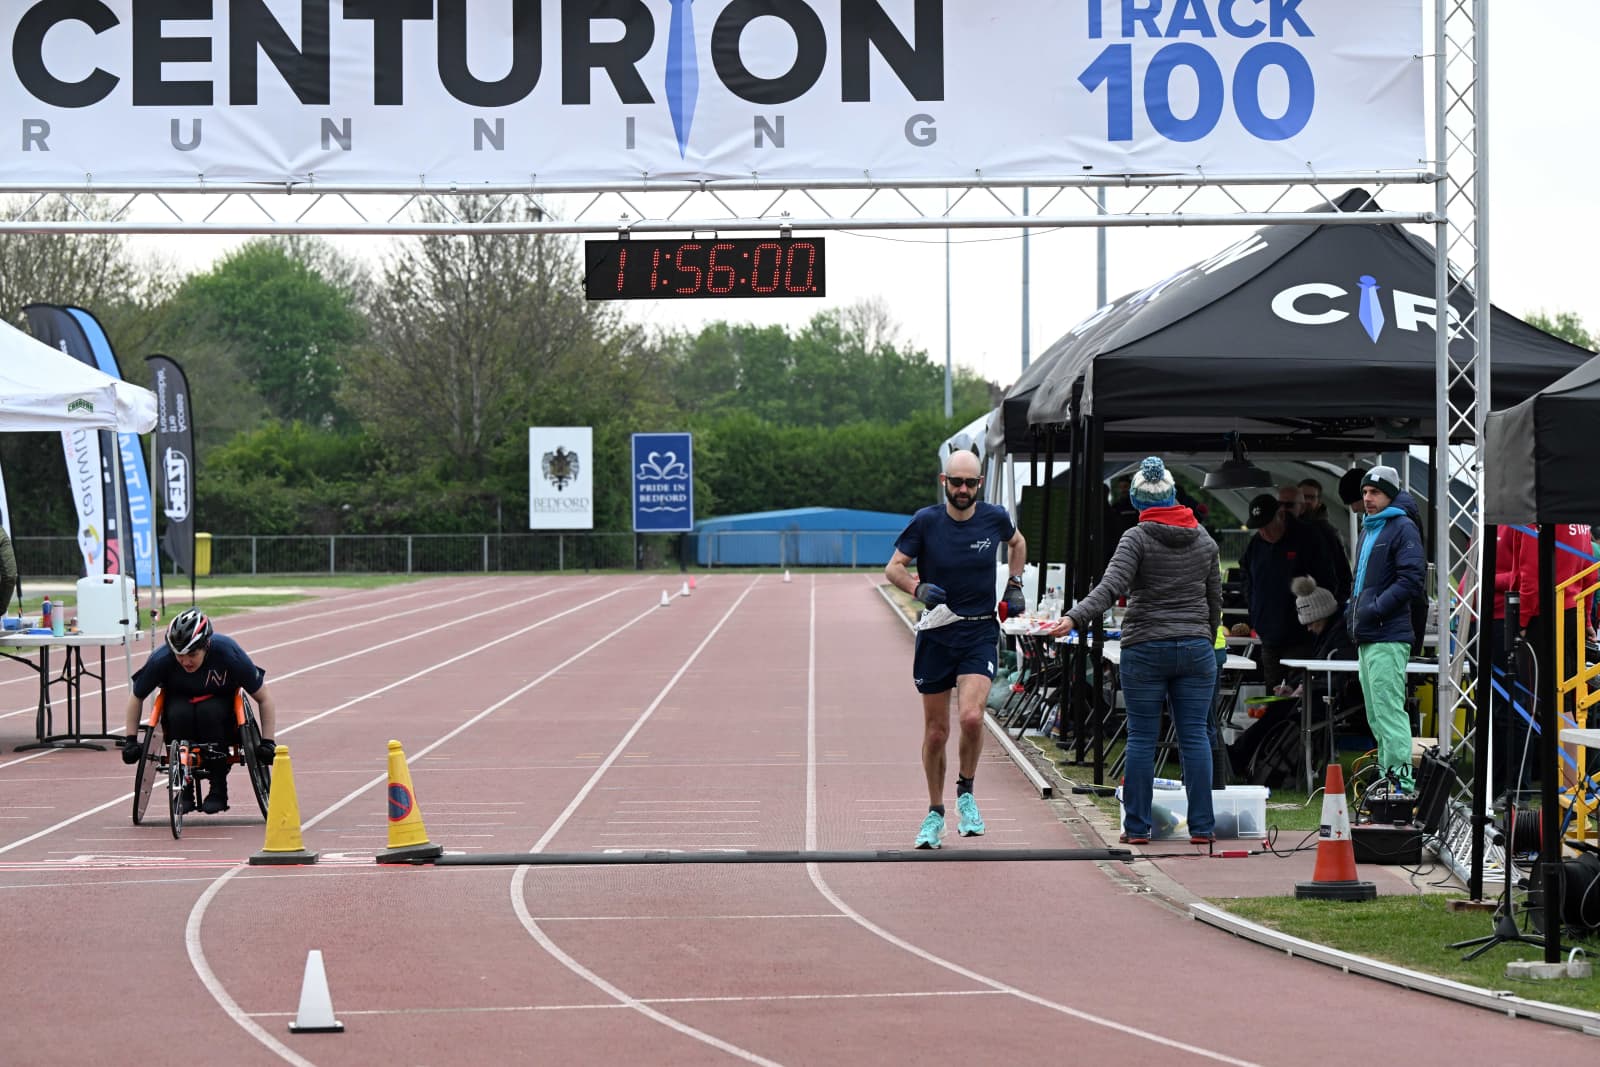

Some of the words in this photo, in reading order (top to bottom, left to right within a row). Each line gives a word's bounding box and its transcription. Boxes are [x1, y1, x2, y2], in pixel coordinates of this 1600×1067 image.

[12, 0, 945, 112] CENTURION
[1077, 41, 1316, 143] 100
[639, 483, 669, 492] PRIDE
[673, 483, 686, 492] IN
[533, 496, 590, 508] BEDFORD
[639, 494, 687, 503] BEDFORD
